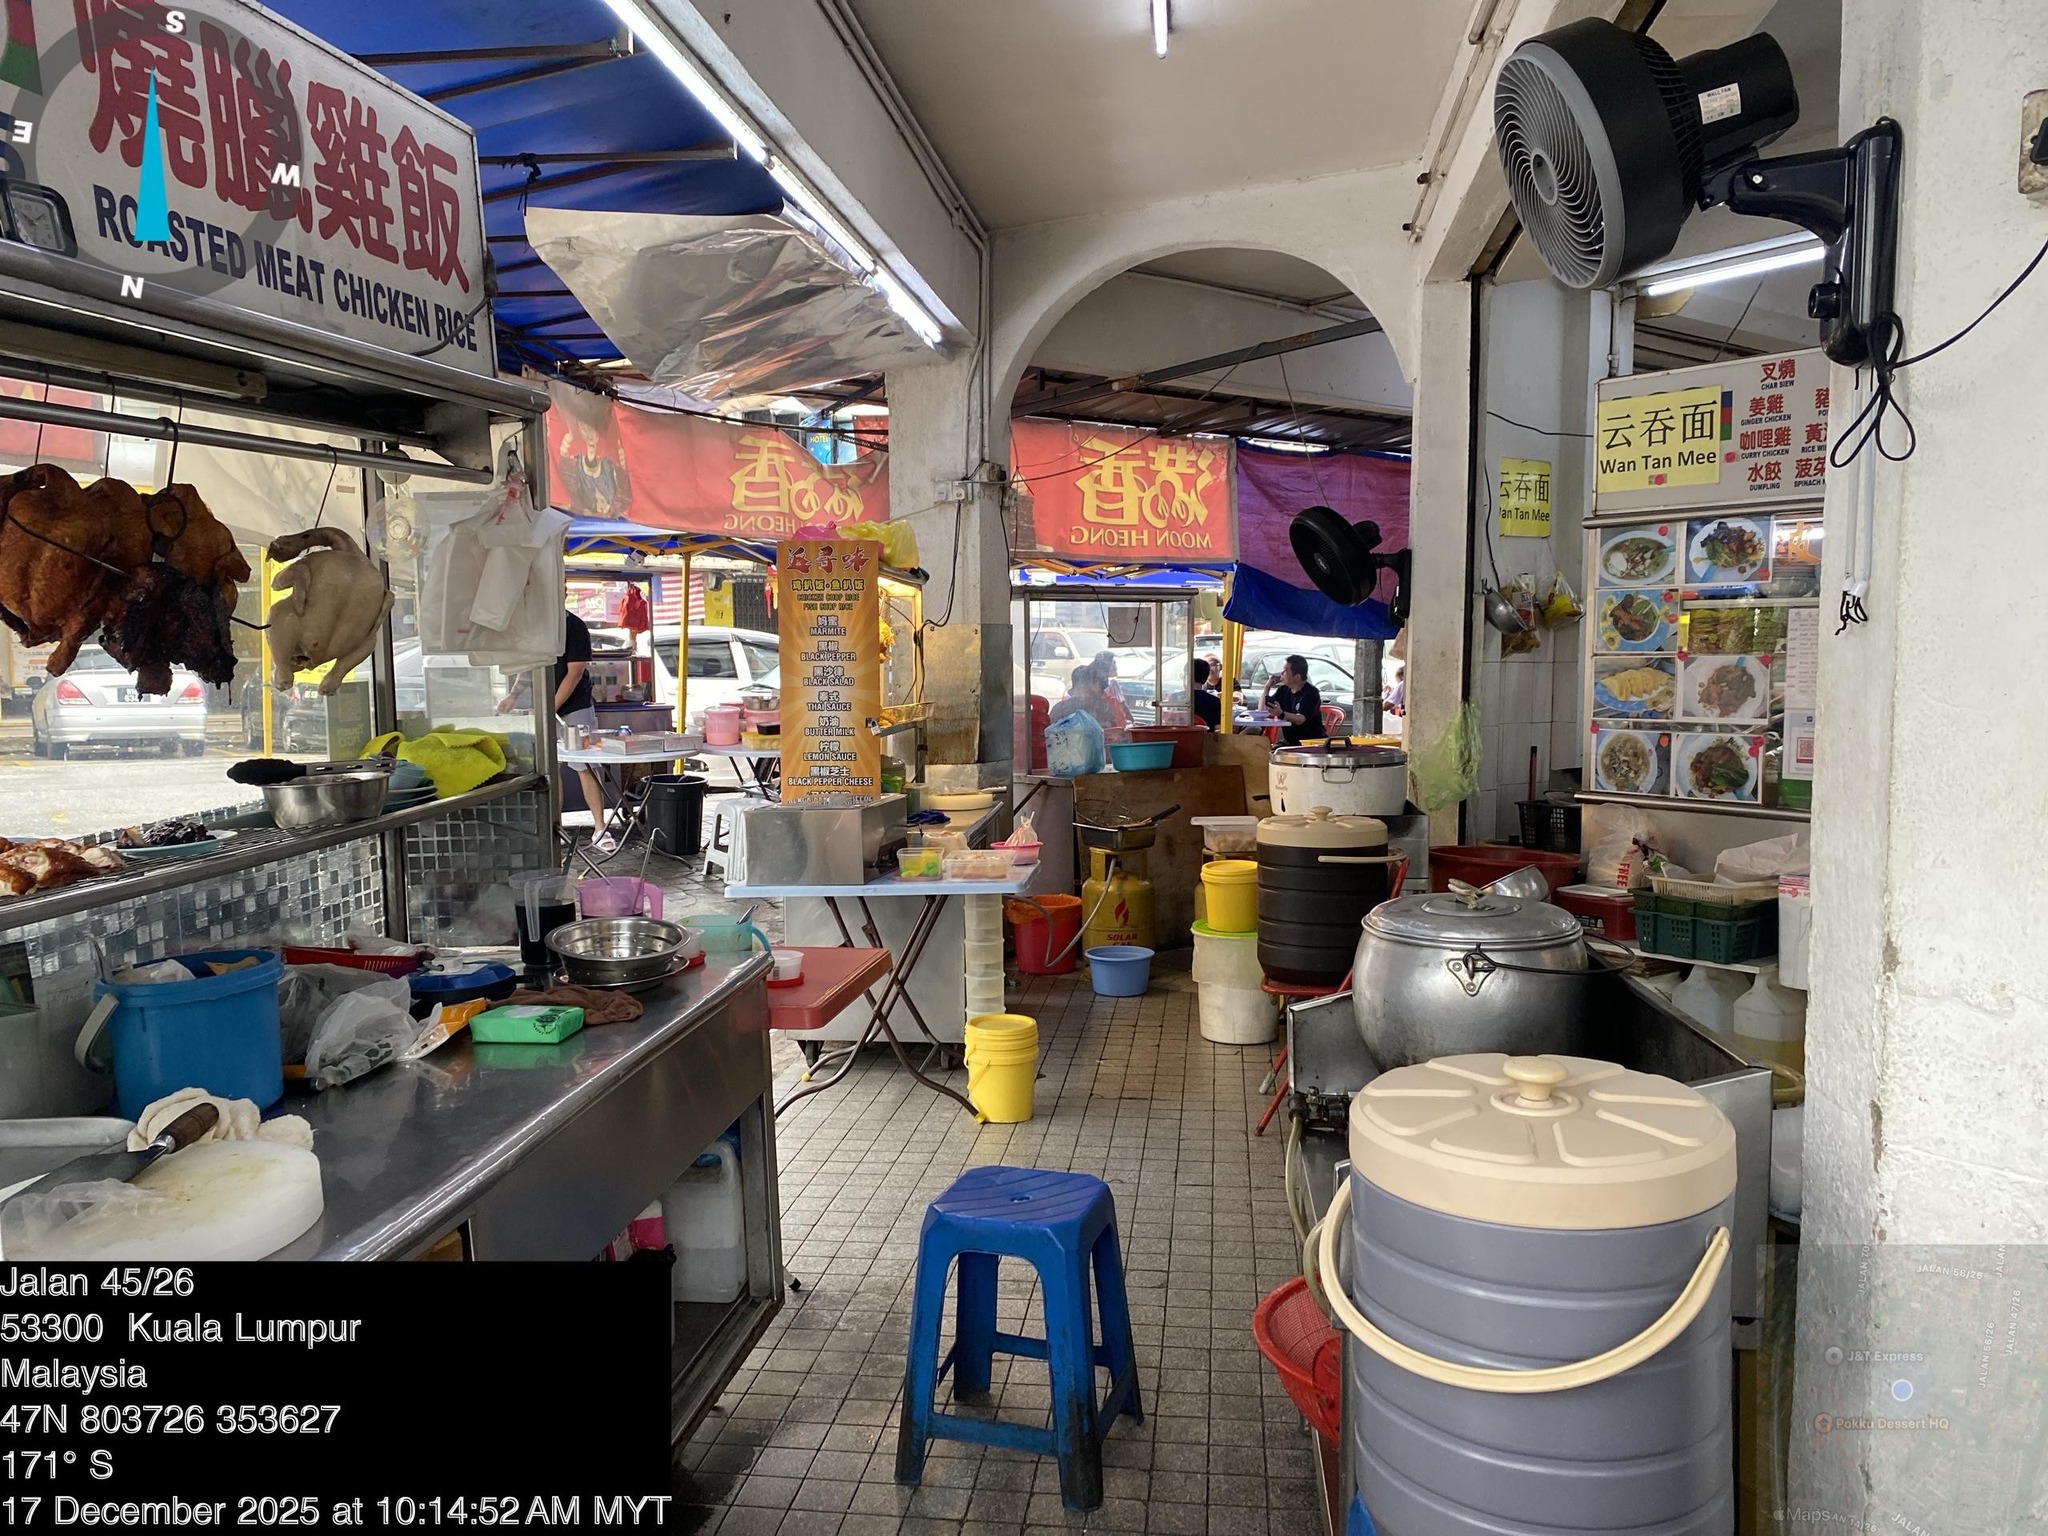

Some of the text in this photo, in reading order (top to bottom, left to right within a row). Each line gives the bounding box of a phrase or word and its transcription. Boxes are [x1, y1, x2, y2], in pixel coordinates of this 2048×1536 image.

[92, 183, 247, 280] ROSTED
[253, 240, 326, 305] MEAT
[333, 267, 430, 345] CHICKEN
[435, 301, 478, 353] RICE
[1760, 358, 1796, 383] 叉燒
[1761, 380, 1795, 391] CHAR SIEW
[1749, 393, 1784, 418] 姜雞
[1602, 399, 1718, 451] 云吞面
[1740, 413, 1792, 426] GINGER CHICKEN
[1739, 425, 1792, 451] 咖哩雞
[1741, 448, 1790, 460] CURRY CHICKEN
[1801, 446, 1816, 454] RICE
[1600, 449, 1717, 474] Wan Tan Mee
[1747, 460, 1782, 483] 水餃
[1500, 471, 1550, 504] 云吞面
[1750, 482, 1780, 492] DUMPLING
[1794, 479, 1823, 488] SPINACH
[1514, 507, 1530, 521] Tan
[1532, 507, 1550, 522] Mee
[810, 627, 846, 637] MARMITE
[801, 652, 857, 661] BLACK PEPPER
[803, 677, 855, 686] BLACK SALAD
[807, 702, 852, 711] THAI SAUCE
[804, 727, 855, 736] BUTTER MILK
[803, 752, 857, 761] LEMON SAUCE
[788, 777, 873, 786] BLACK PEPPER CHEESE
[1106, 932, 1138, 941] SOLAR
